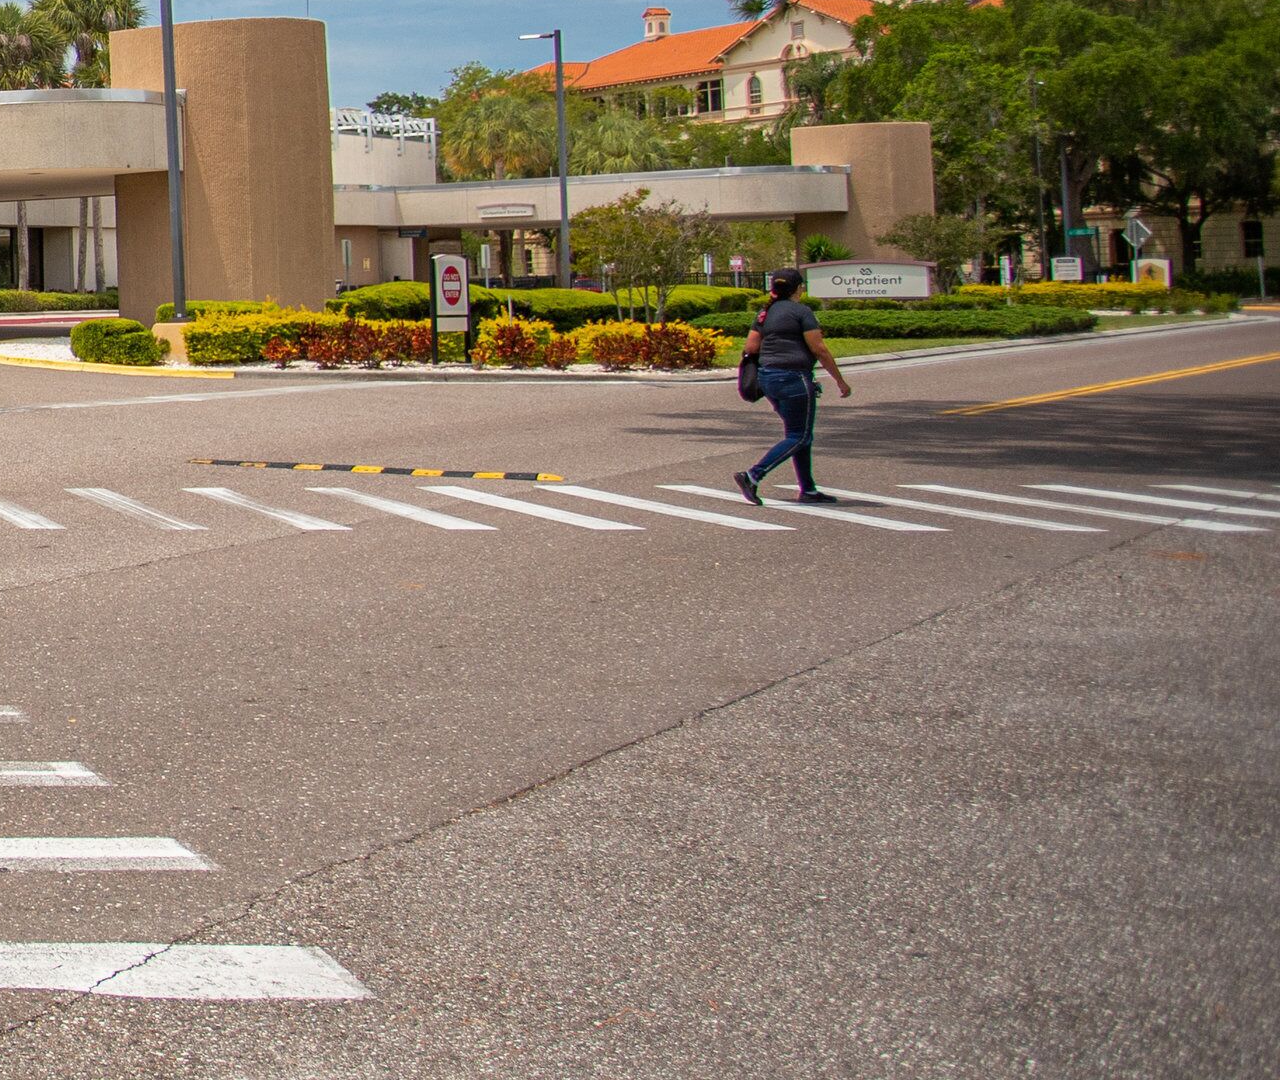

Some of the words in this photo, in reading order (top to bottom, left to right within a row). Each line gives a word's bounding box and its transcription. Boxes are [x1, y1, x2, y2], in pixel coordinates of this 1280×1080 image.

[443, 273, 451, 281] DO
[452, 273, 460, 281] NOT
[831, 274, 903, 287] Outpatient
[445, 290, 460, 298] ENTER
[847, 287, 887, 295] Entrance
